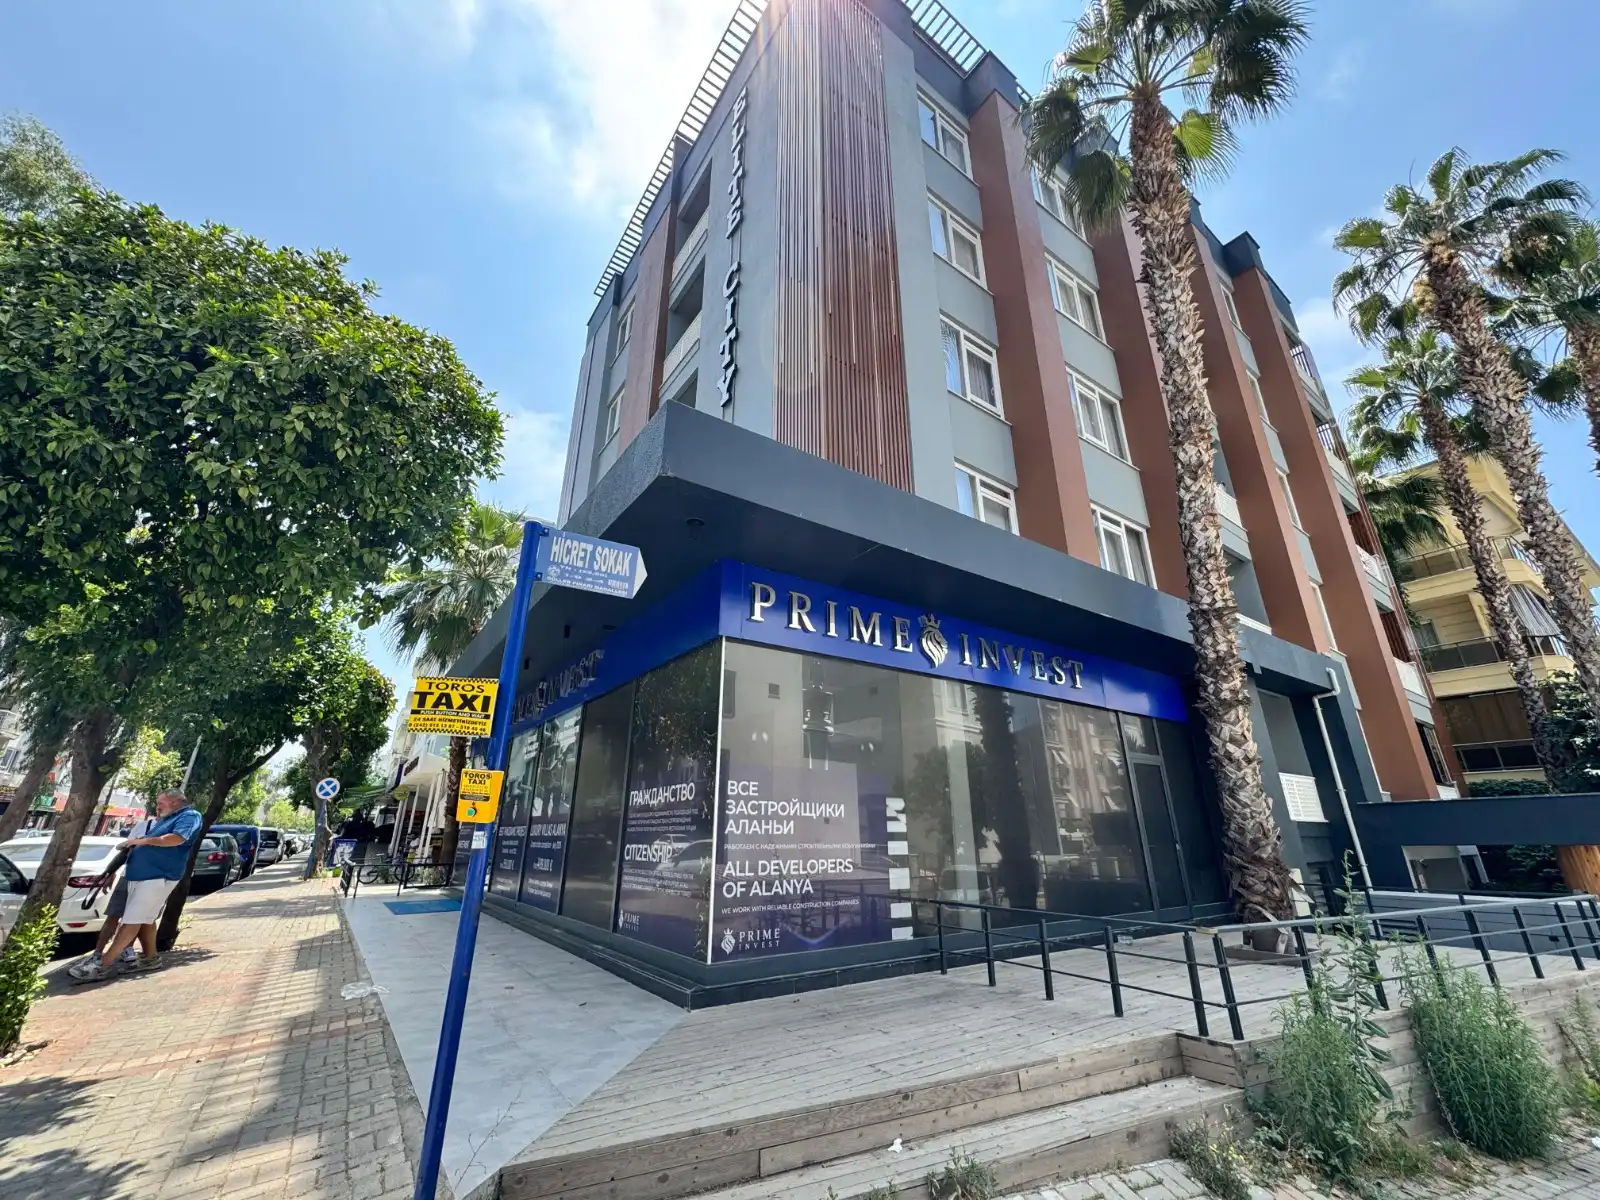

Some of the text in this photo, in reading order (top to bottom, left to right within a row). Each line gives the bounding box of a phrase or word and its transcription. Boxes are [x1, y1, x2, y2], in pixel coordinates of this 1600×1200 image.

[716, 86, 748, 408] ELITE CITY
[550, 532, 594, 569] HİCRET
[593, 546, 633, 577] SOKAK
[748, 581, 1084, 690] PRIME INVEST
[426, 681, 485, 693] TOROS
[414, 691, 491, 713] TAXI
[464, 771, 491, 780] TOROS
[629, 782, 696, 807] ГРАЖДАНСТВО
[727, 780, 759, 796] ВСЕ
[725, 798, 845, 819] ЗАСТРОЙЩИКИ
[724, 819, 794, 835] АЛАНЬИ
[624, 843, 672, 863] CITIZENSHIP
[723, 858, 854, 877] ALL DEVELOPERS
[722, 878, 814, 898] OF ALANYA
[766, 903, 792, 911] RELIABLE
[792, 901, 831, 909] CONSTRUCTION
[739, 928, 781, 943] PRIME
[738, 940, 780, 951] INVEST
